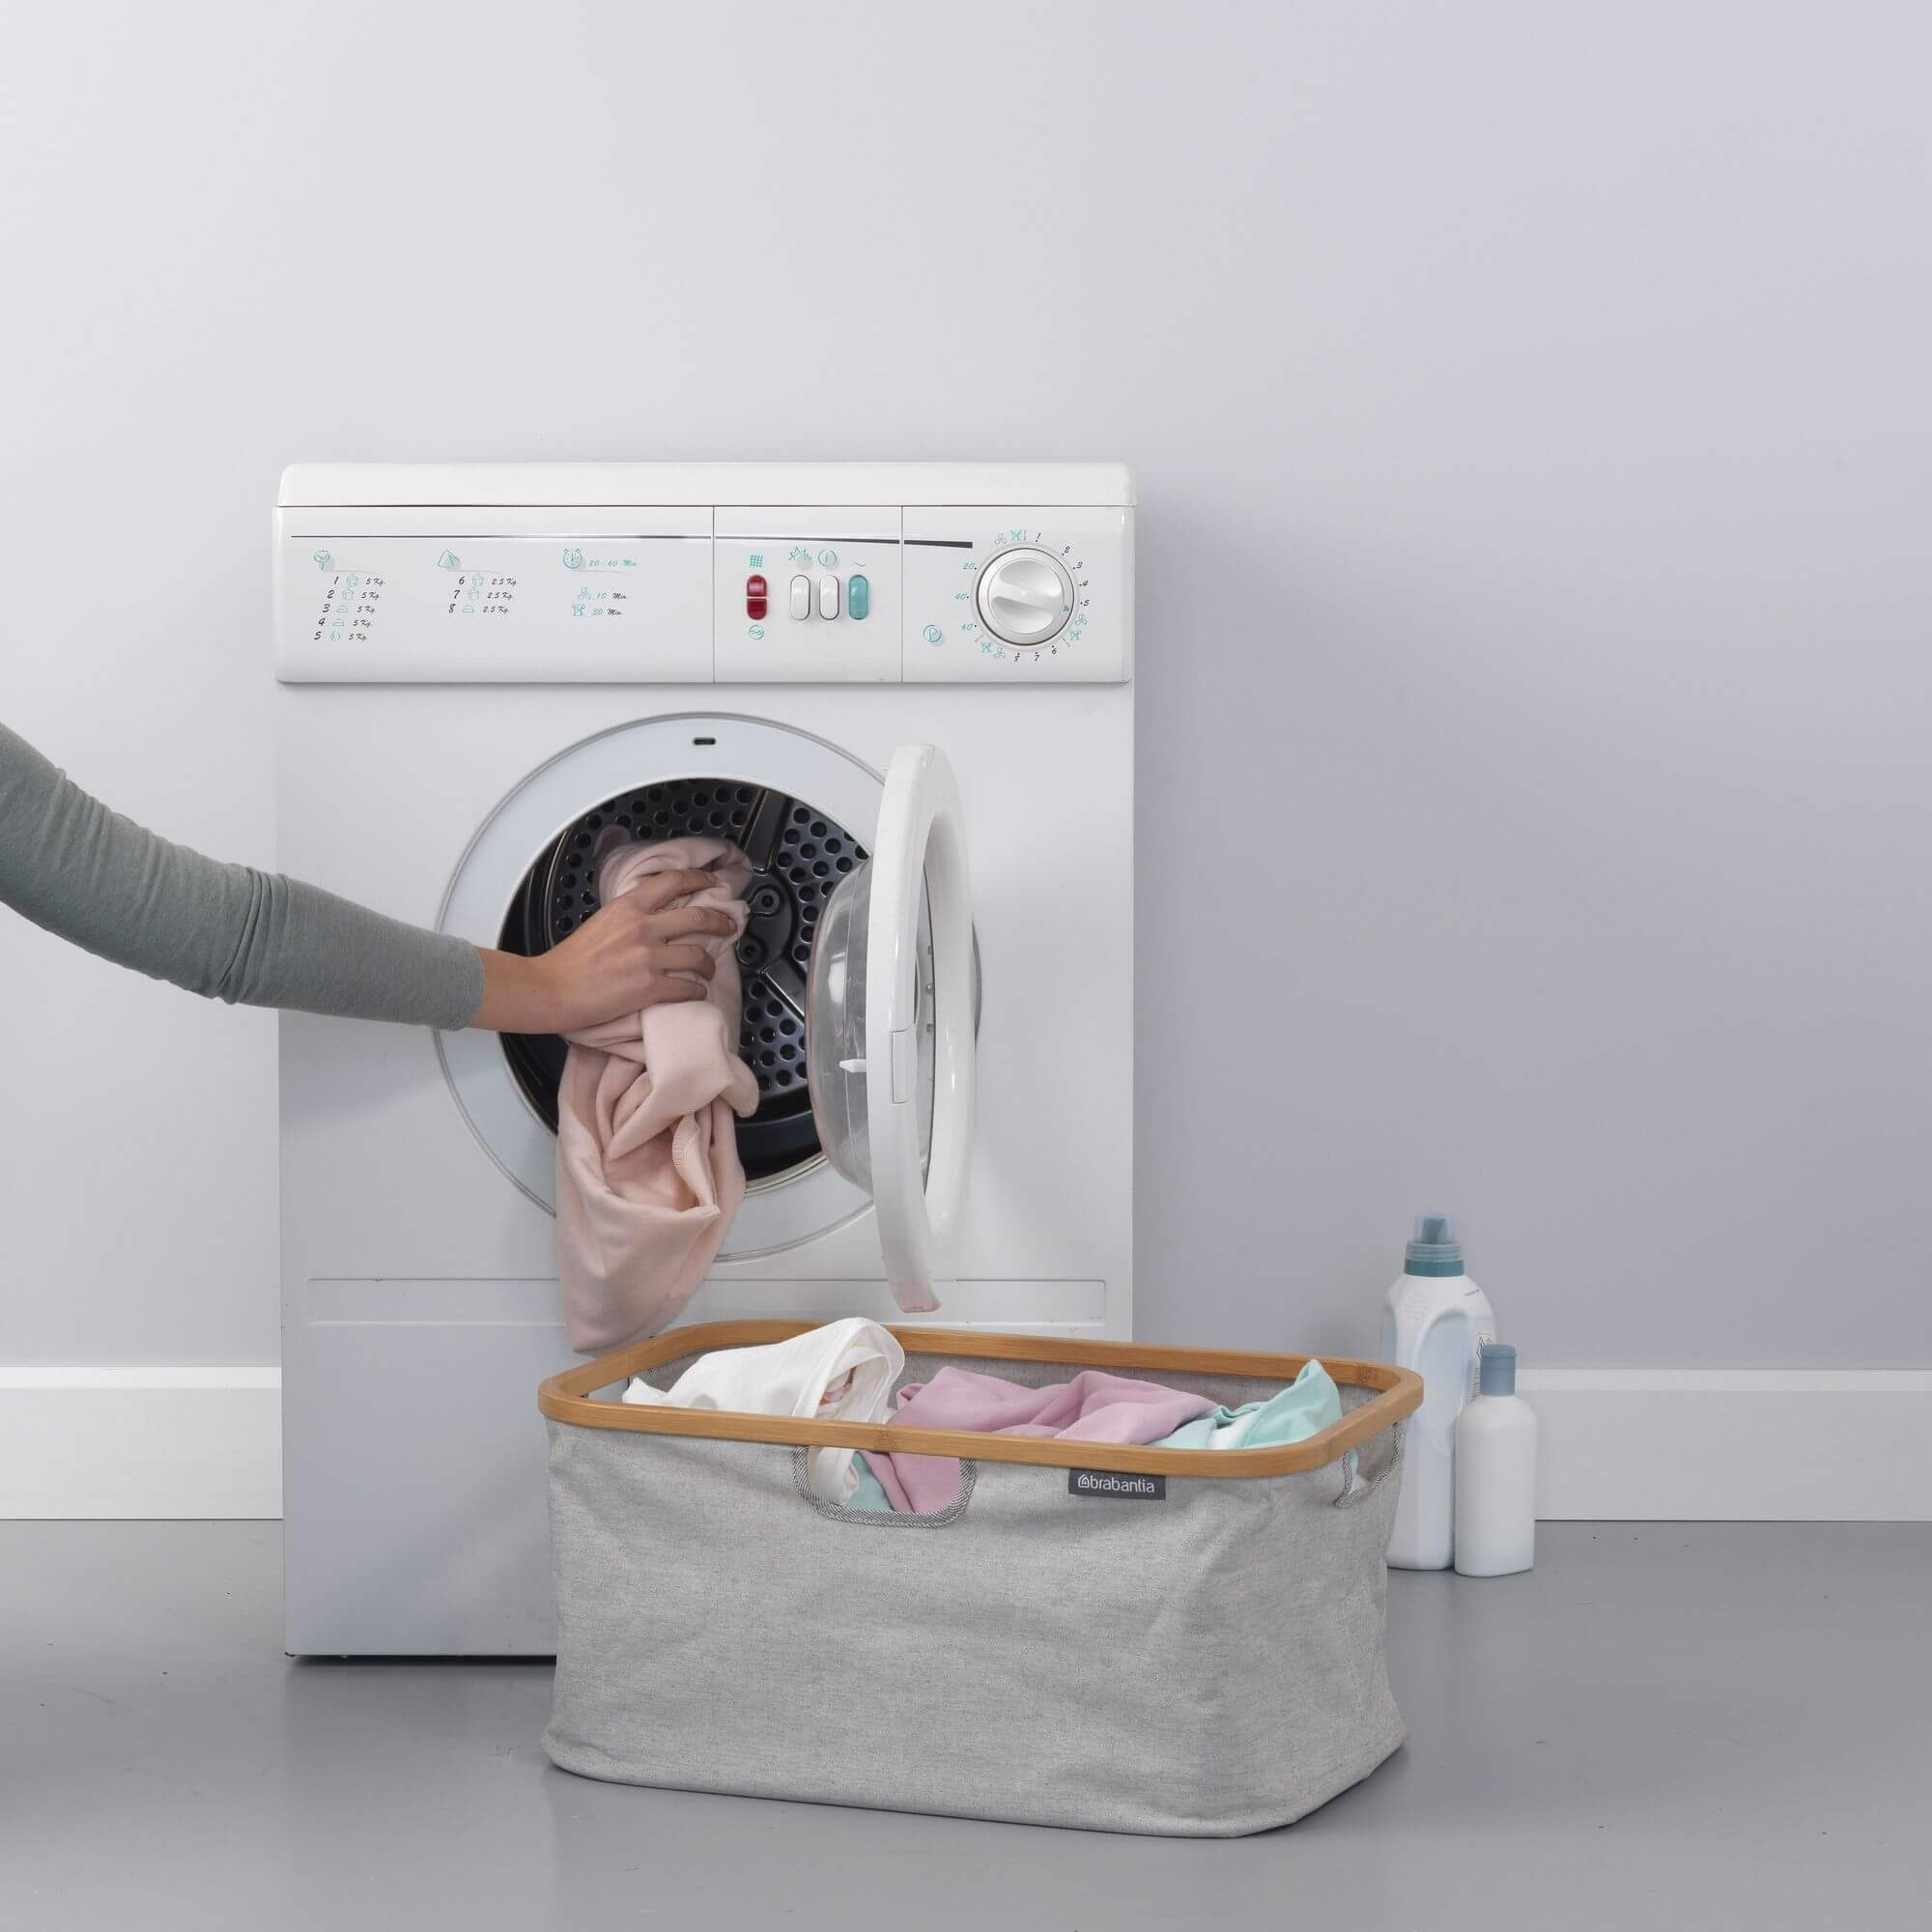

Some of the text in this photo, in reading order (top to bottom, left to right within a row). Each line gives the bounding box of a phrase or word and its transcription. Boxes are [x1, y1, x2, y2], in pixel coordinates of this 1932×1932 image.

[333, 576, 339, 585] 1
[458, 576, 466, 585] 6
[327, 590, 335, 599] 2
[453, 590, 460, 599] 7
[323, 603, 330, 612] 3
[448, 604, 456, 613] 8
[318, 617, 326, 626] 4
[314, 631, 322, 640] 5
[1090, 1474, 1155, 1493] brabantia
